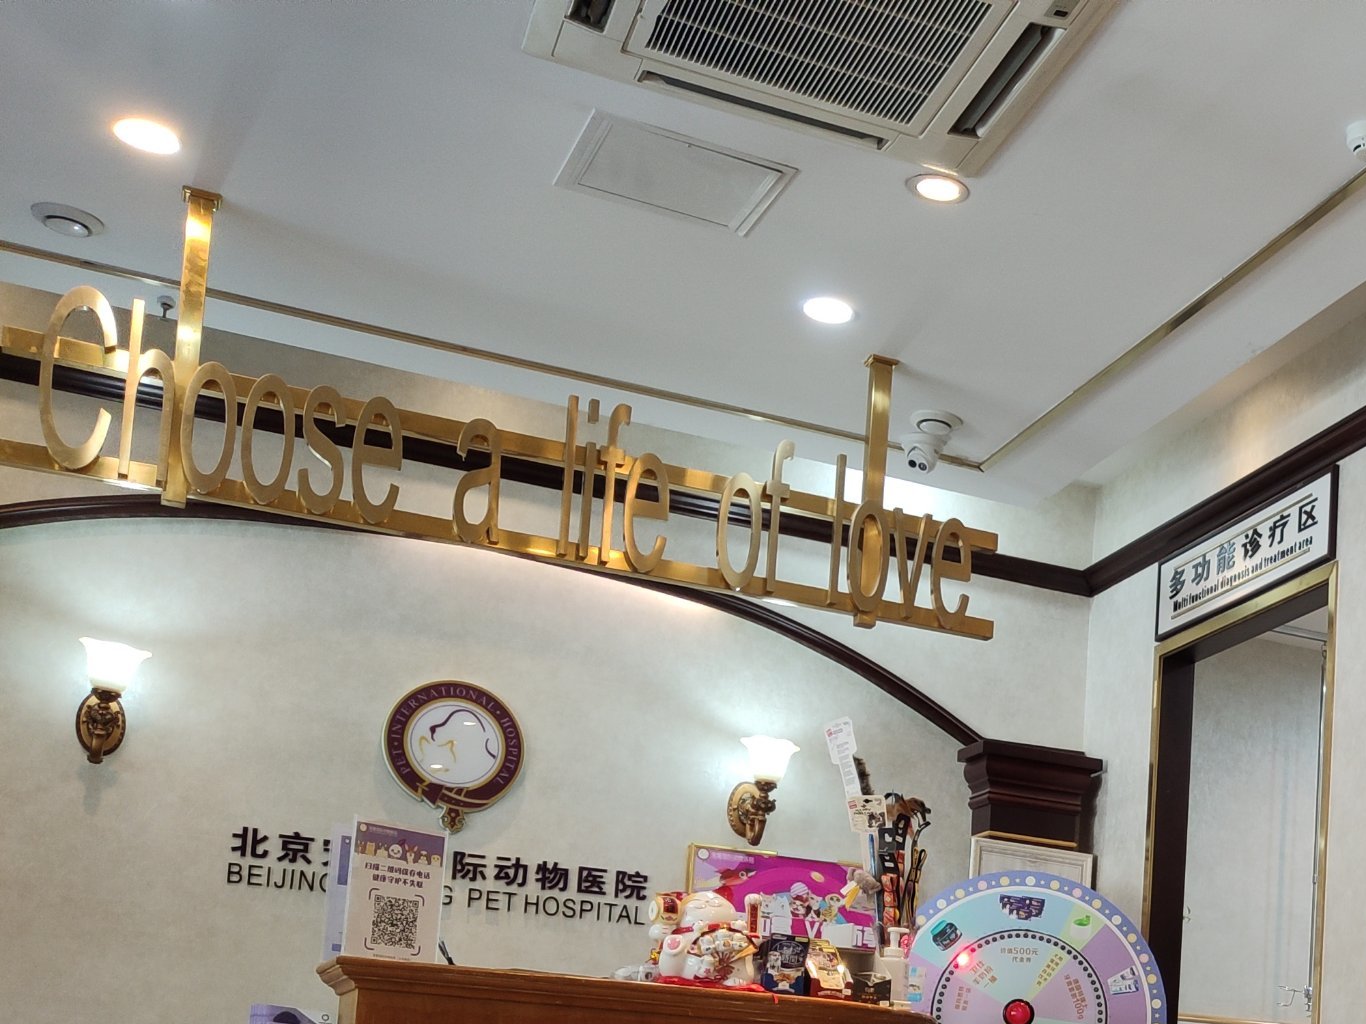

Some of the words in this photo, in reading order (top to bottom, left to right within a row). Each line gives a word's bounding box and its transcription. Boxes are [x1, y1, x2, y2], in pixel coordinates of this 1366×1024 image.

[39, 285, 402, 523] Choose
[453, 418, 501, 545] a
[556, 394, 671, 573] life
[716, 440, 796, 592] of
[826, 453, 972, 629] love
[1169, 497, 1318, 600] 多功能诊疗区
[1220, 565, 1250, 589] diagnosis
[1251, 558, 1263, 573] and
[1264, 541, 1297, 567] treatment
[1298, 536, 1313, 551] area
[391, 685, 498, 738] INTERNATIONAL
[392, 746, 411, 774] PET
[494, 717, 519, 785] HOSPITAL
[231, 826, 330, 867] 北京
[451, 850, 649, 901] 际动物医院
[467, 888, 518, 913] PET
[524, 894, 646, 926] HOSPITAL
